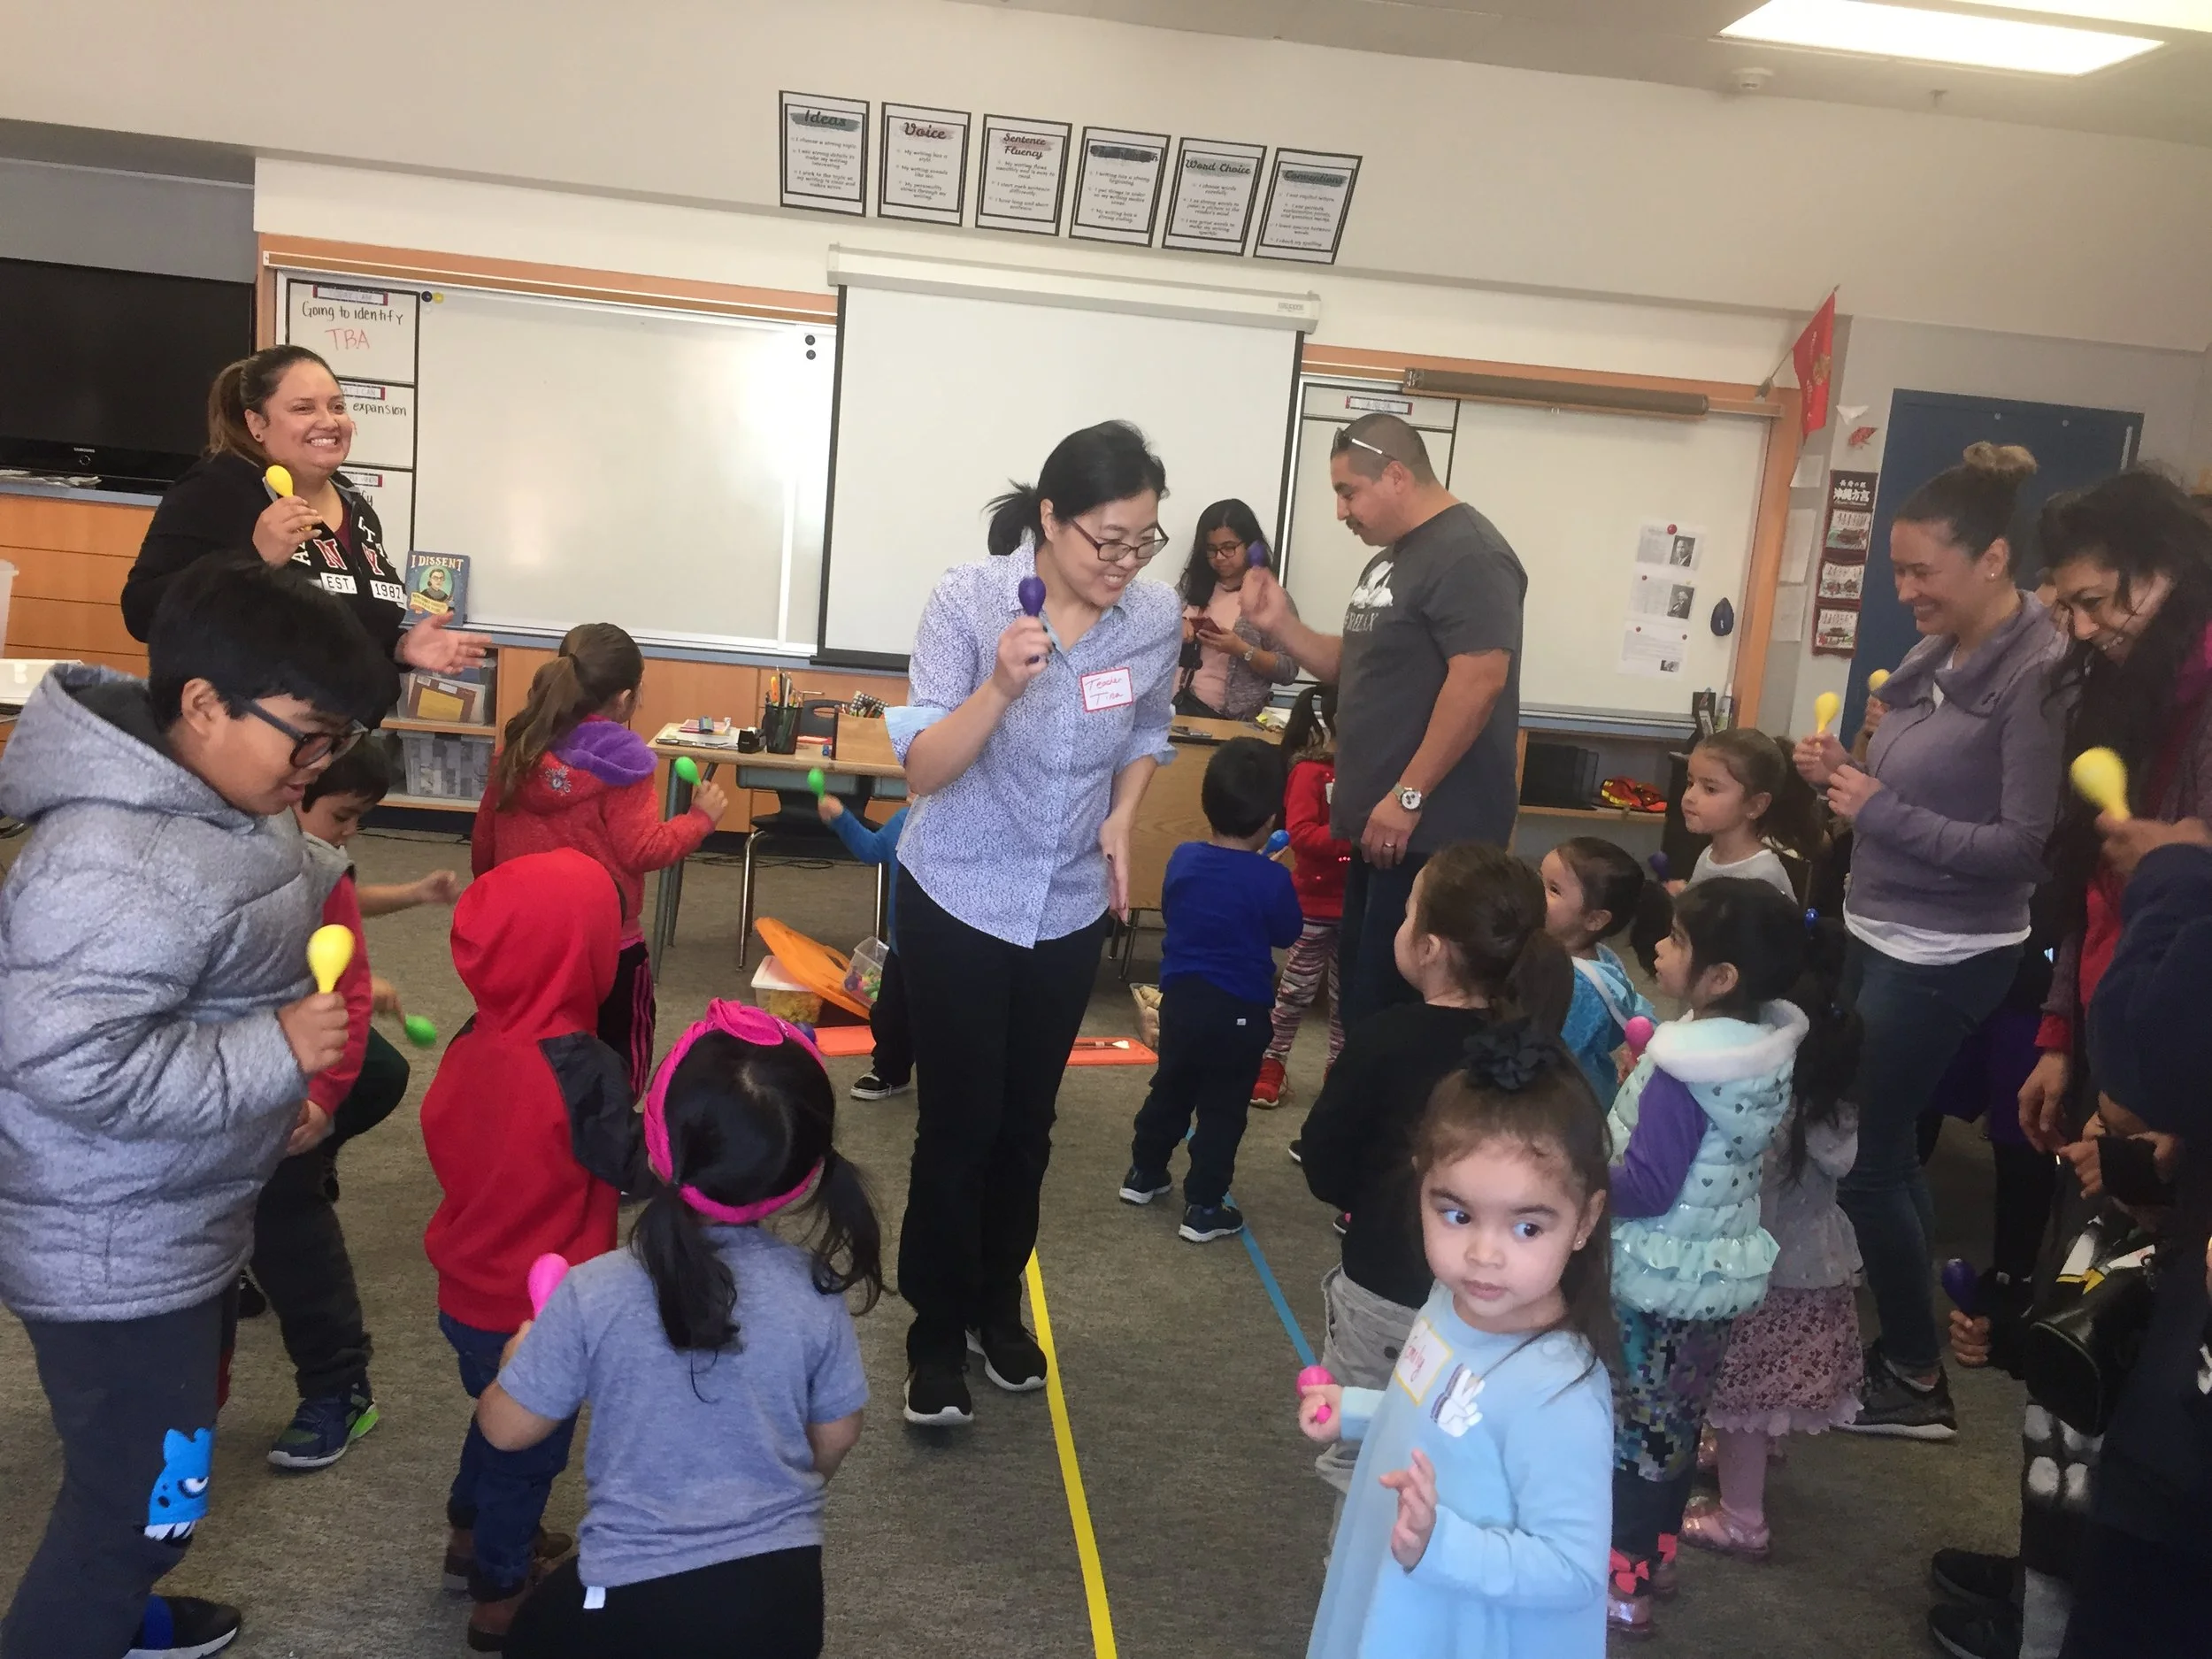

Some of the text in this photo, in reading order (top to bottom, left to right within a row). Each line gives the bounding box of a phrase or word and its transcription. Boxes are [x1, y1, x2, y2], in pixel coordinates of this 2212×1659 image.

[803, 109, 847, 127] Ideas
[903, 122, 947, 140] Voice
[1003, 133, 1047, 145] Sentence
[1004, 145, 1043, 160] Fluency
[1186, 159, 1251, 174] Word Choice
[302, 301, 403, 326] Going to identify
[325, 328, 371, 351] TBA
[352, 403, 407, 417] expansion
[411, 554, 465, 572] I DISSENT
[326, 576, 401, 599] EST. 1987
[1085, 677, 1122, 691] Teacher
[1090, 692, 1124, 706] Tina
